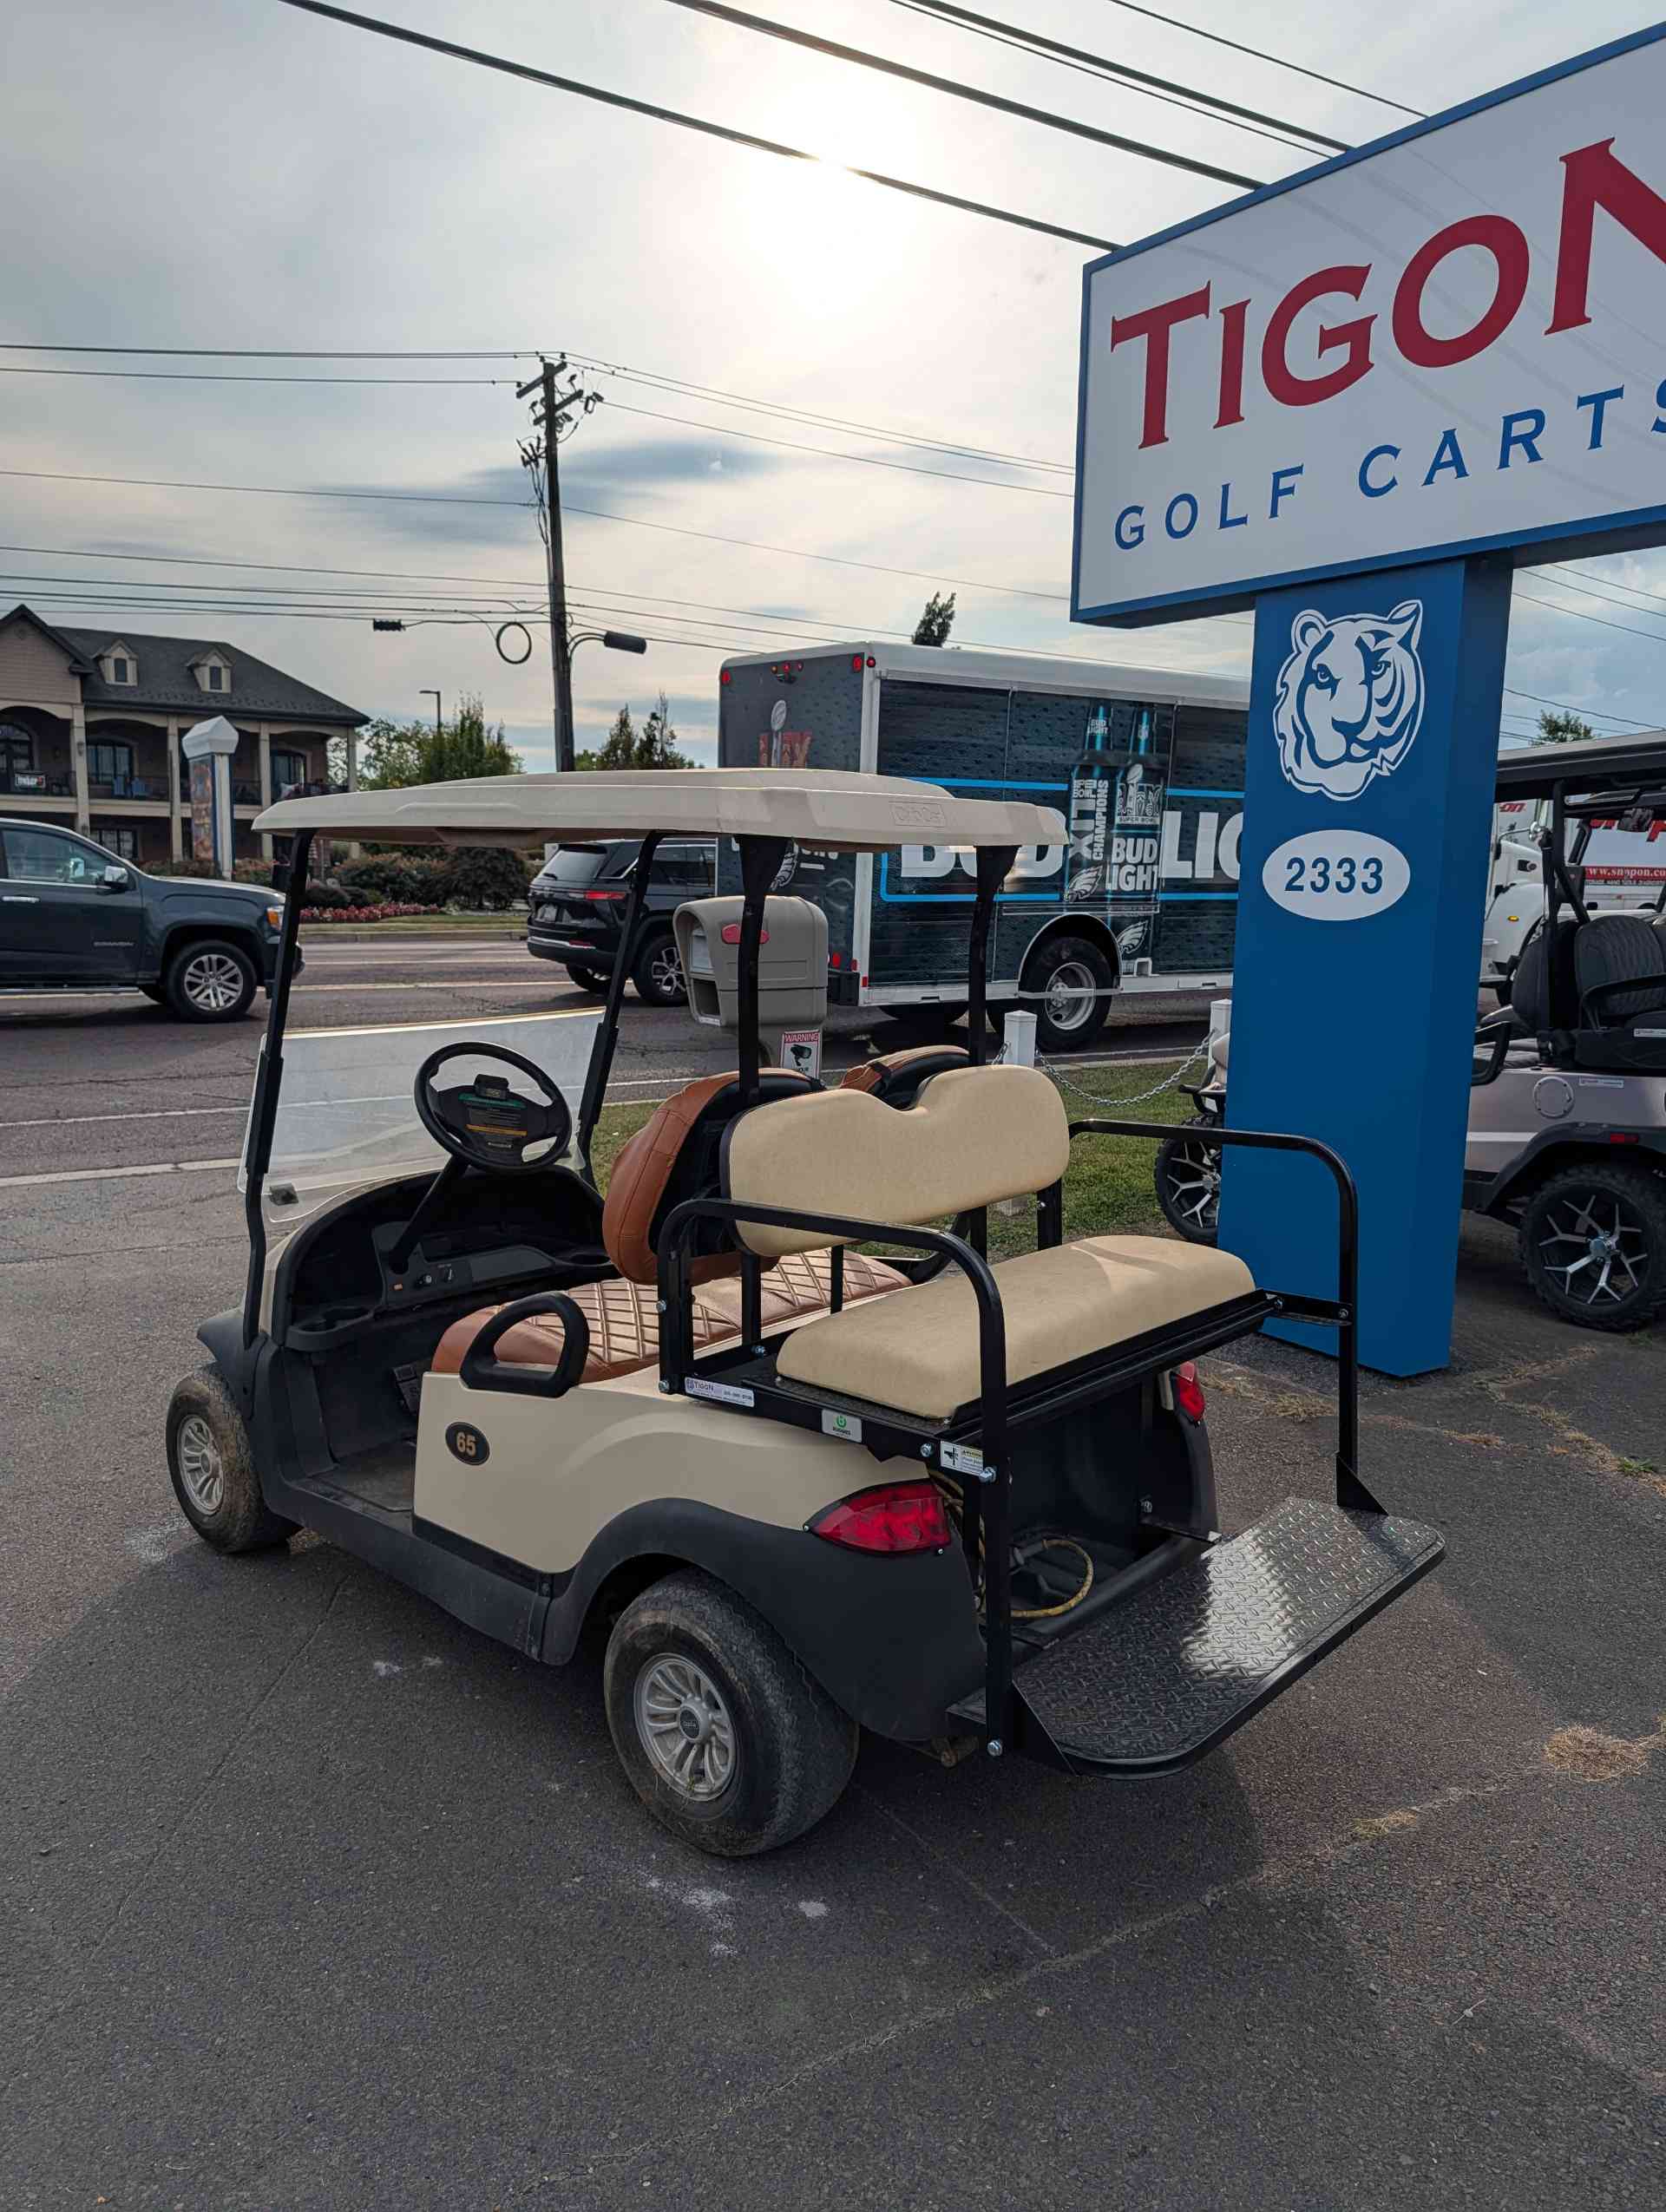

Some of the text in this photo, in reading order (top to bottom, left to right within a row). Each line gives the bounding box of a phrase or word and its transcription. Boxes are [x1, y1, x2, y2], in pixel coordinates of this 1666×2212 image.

[1113, 463, 1304, 550] GOLF
[1092, 780, 1110, 861] CHAMPIONS
[1111, 837, 1158, 864] BUD
[1105, 864, 1160, 892] LIGHT
[1284, 857, 1384, 894] 2333
[784, 1032, 819, 1042] WARNING
[456, 1431, 476, 1457] 65
